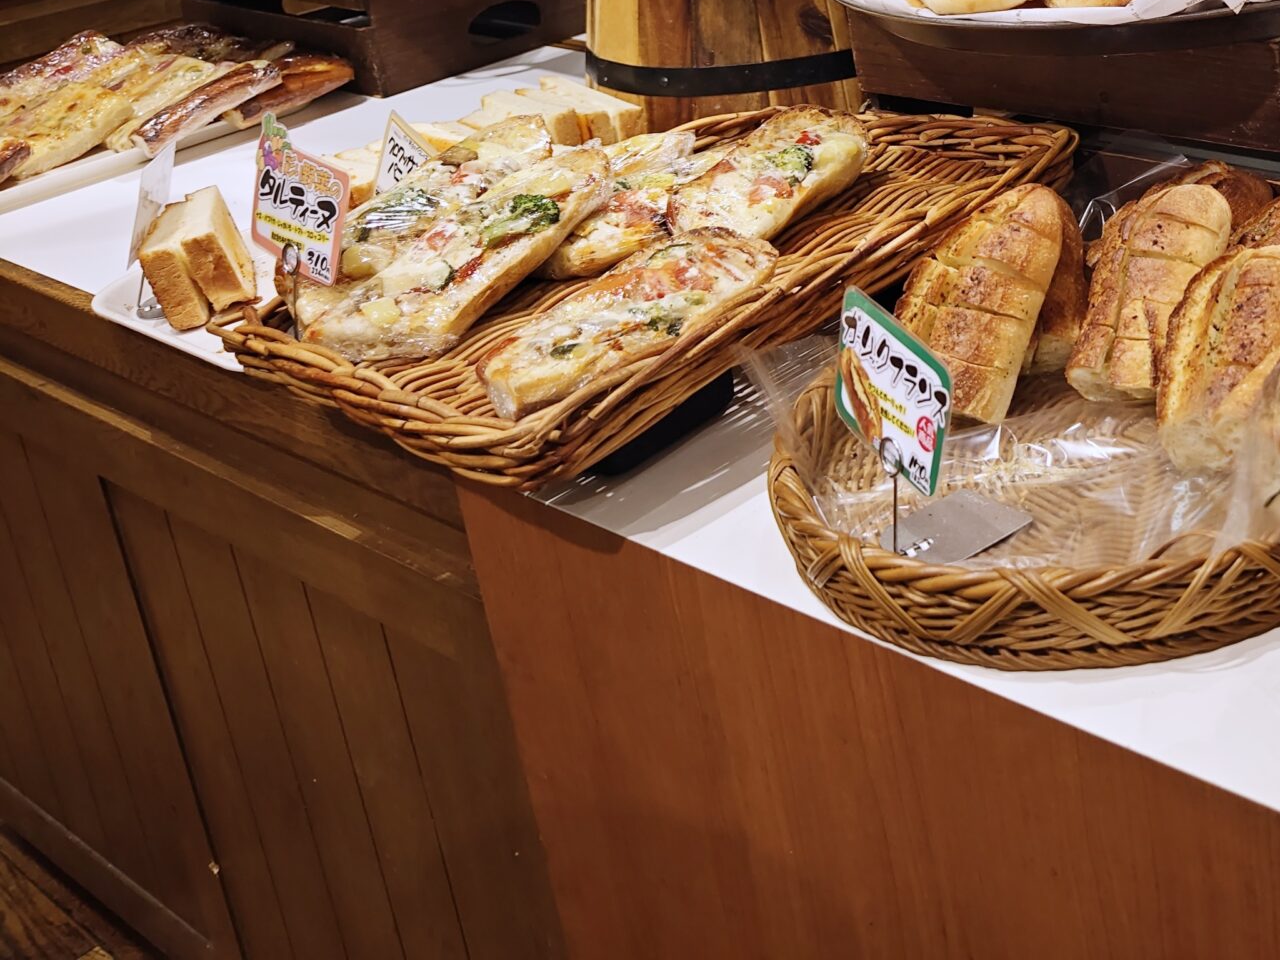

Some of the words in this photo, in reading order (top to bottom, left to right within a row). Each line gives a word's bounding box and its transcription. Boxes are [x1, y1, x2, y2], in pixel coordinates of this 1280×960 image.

[260, 168, 337, 230] タルティーヌ
[844, 311, 947, 420] ガーリックフランス
